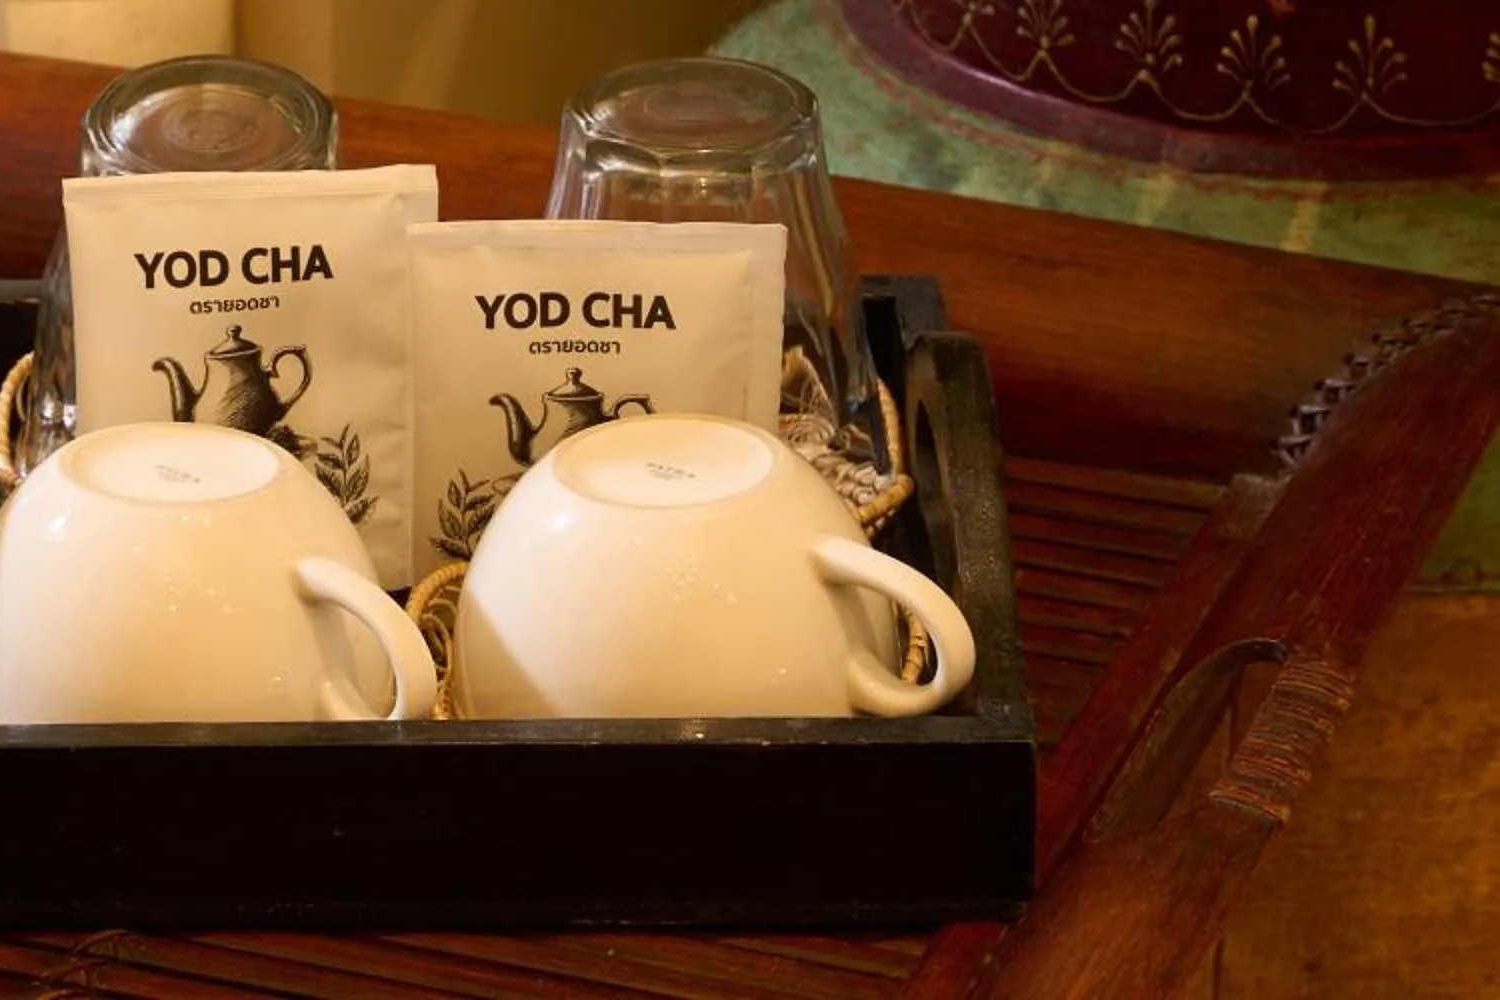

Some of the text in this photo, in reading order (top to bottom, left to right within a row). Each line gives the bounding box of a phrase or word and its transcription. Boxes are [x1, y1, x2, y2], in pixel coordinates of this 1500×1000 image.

[133, 244, 334, 290] YOD CHA
[189, 295, 280, 315] ตรายอดชา
[474, 292, 677, 330] YOD CHA
[529, 339, 621, 356] ตรายอดชา
